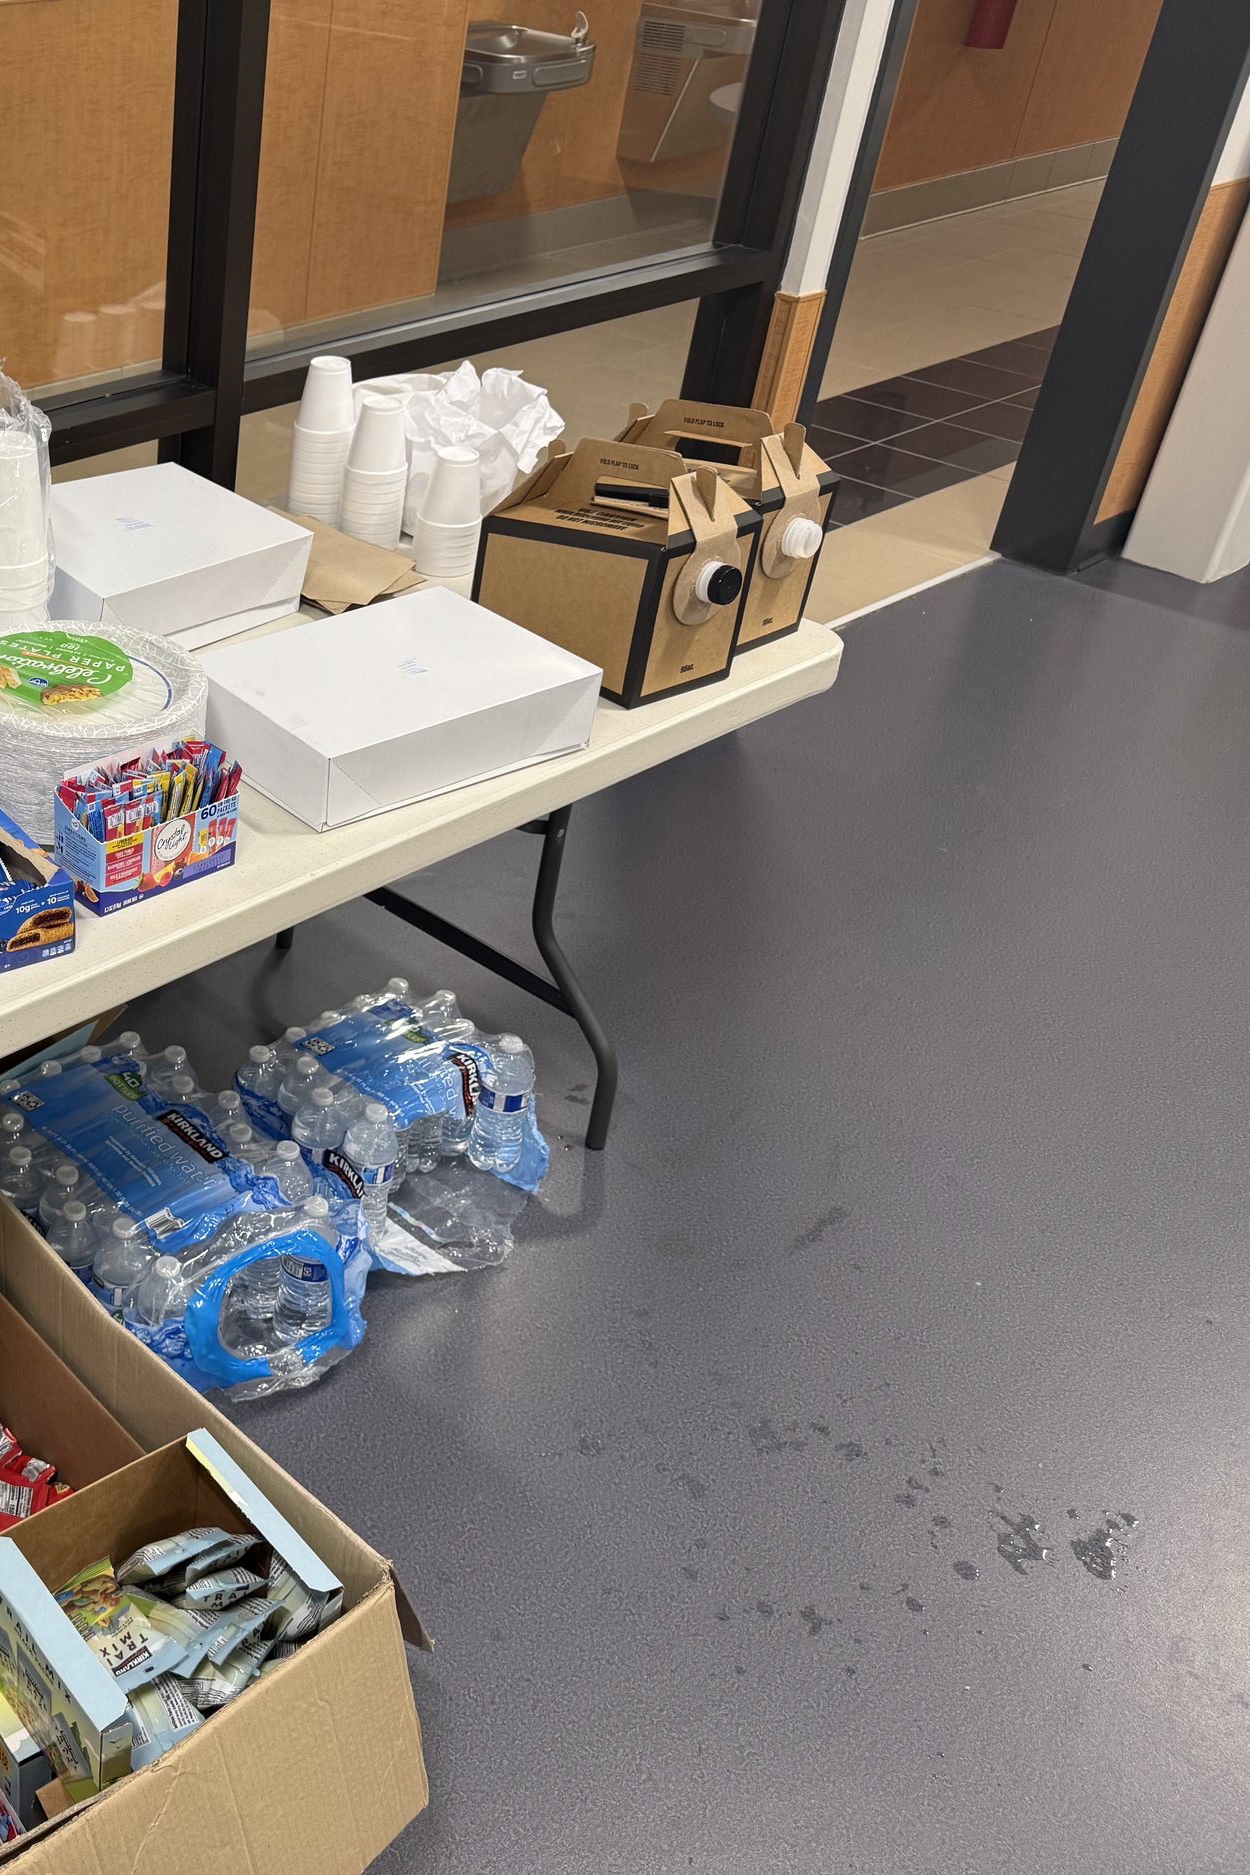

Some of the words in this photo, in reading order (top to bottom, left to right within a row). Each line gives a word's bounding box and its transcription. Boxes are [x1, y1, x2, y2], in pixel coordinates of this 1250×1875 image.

[683, 416, 695, 425] FOLD
[695, 418, 706, 426] FLAP
[712, 420, 725, 428] LOCK
[600, 458, 611, 466] FOLD
[611, 460, 622, 468] FLAP
[628, 462, 639, 470] LOCK
[567, 515, 581, 523] NOT
[580, 517, 630, 531] MICROWAVE
[0, 639, 63, 660] PLATES
[69, 656, 127, 672] PAPER
[200, 804, 217, 820] 60
[217, 802, 237, 814] PACKETS
[157, 823, 185, 849] Crystal
[169, 831, 189, 850] Light
[15, 903, 30, 914] 10g
[46, 897, 57, 905] 10
[109, 1075, 136, 1099] BOTTLES
[122, 1072, 140, 1088] 40
[110, 1104, 176, 1153] purified
[170, 1151, 218, 1186] water
[166, 1112, 224, 1159] KIRKLAND
[101, 1631, 132, 1656] MIX
[107, 1632, 149, 1667] TRAI
[115, 1649, 150, 1677] KIRKLAND
[45, 1663, 71, 1704] MIX
